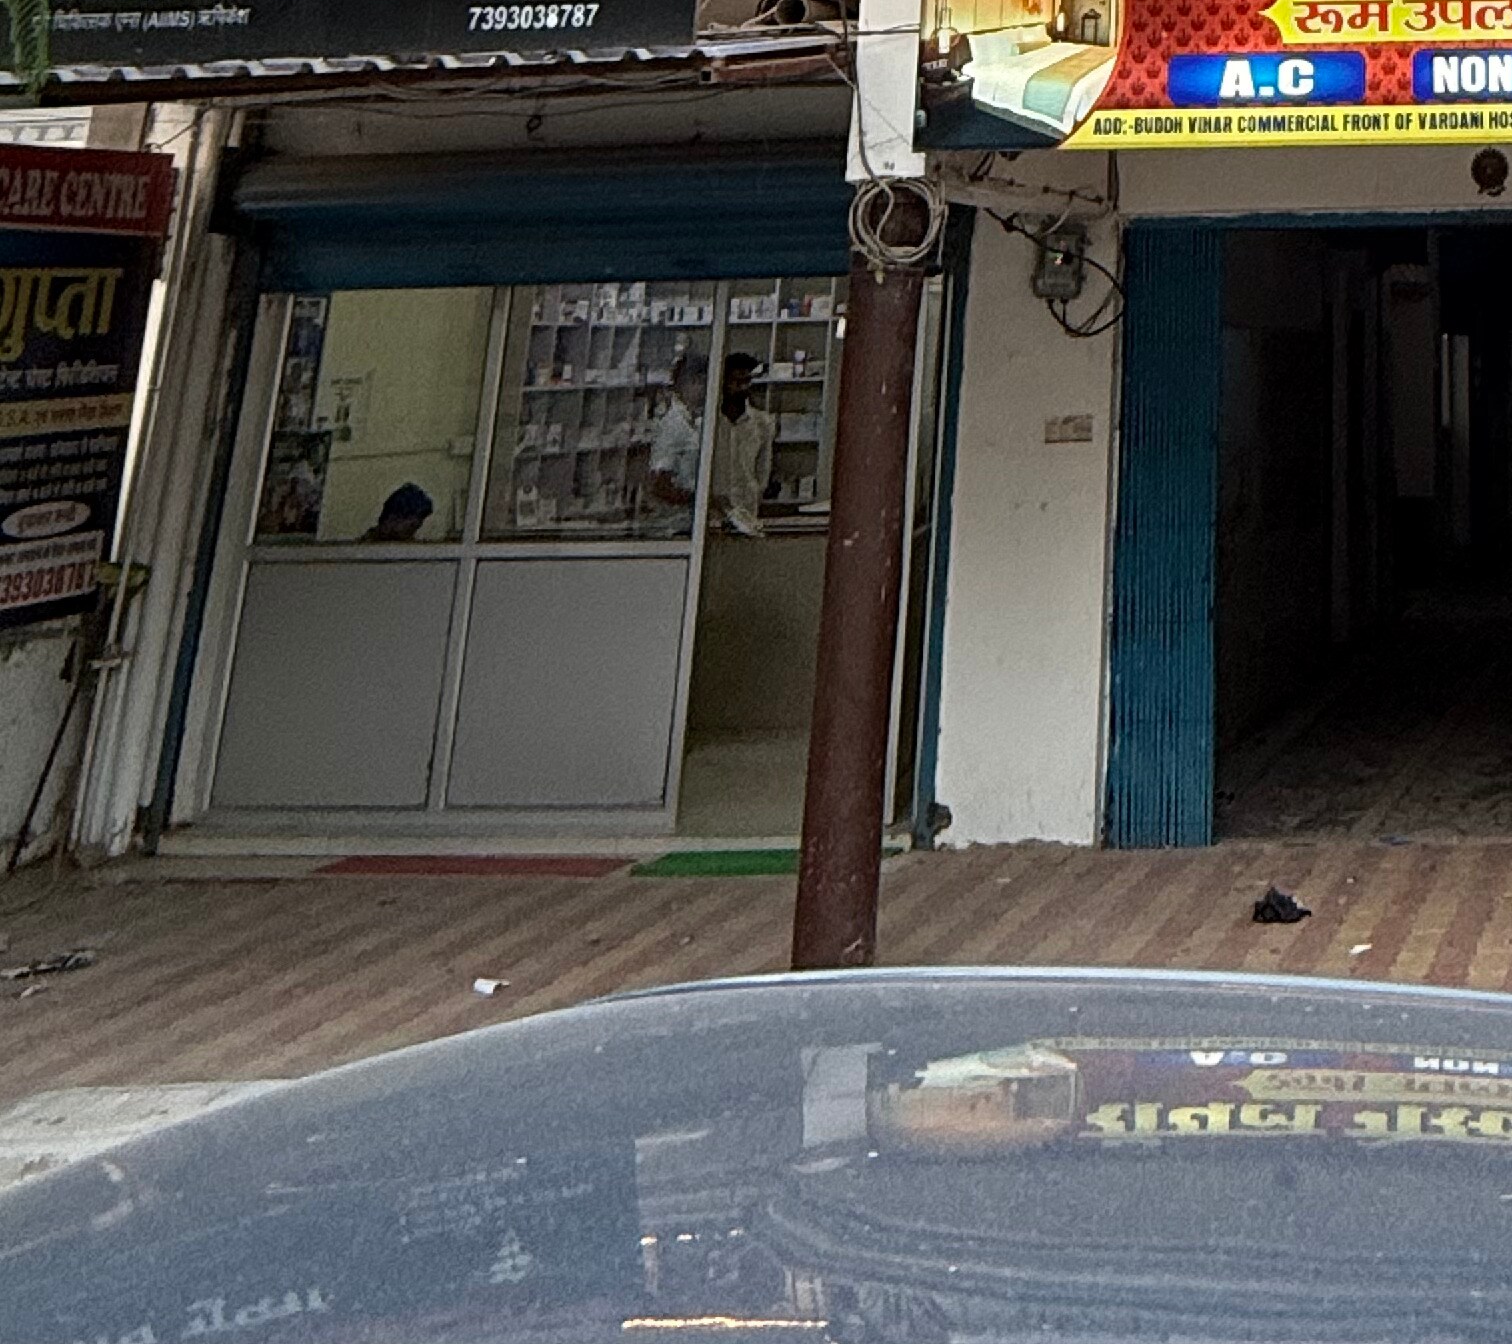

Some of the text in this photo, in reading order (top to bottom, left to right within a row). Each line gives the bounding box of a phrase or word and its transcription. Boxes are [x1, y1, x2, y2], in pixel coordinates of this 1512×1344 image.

[469, 3, 599, 31] 7393038787
[1291, 0, 1394, 34] रूम
[1218, 58, 1315, 98] A.C
[1187, 115, 1232, 134] VIHAR
[1237, 113, 1339, 133] COMMERCIAL
[1343, 112, 1391, 132] FRONT
[1395, 112, 1414, 131] OF
[1418, 111, 1484, 131] VARDANI
